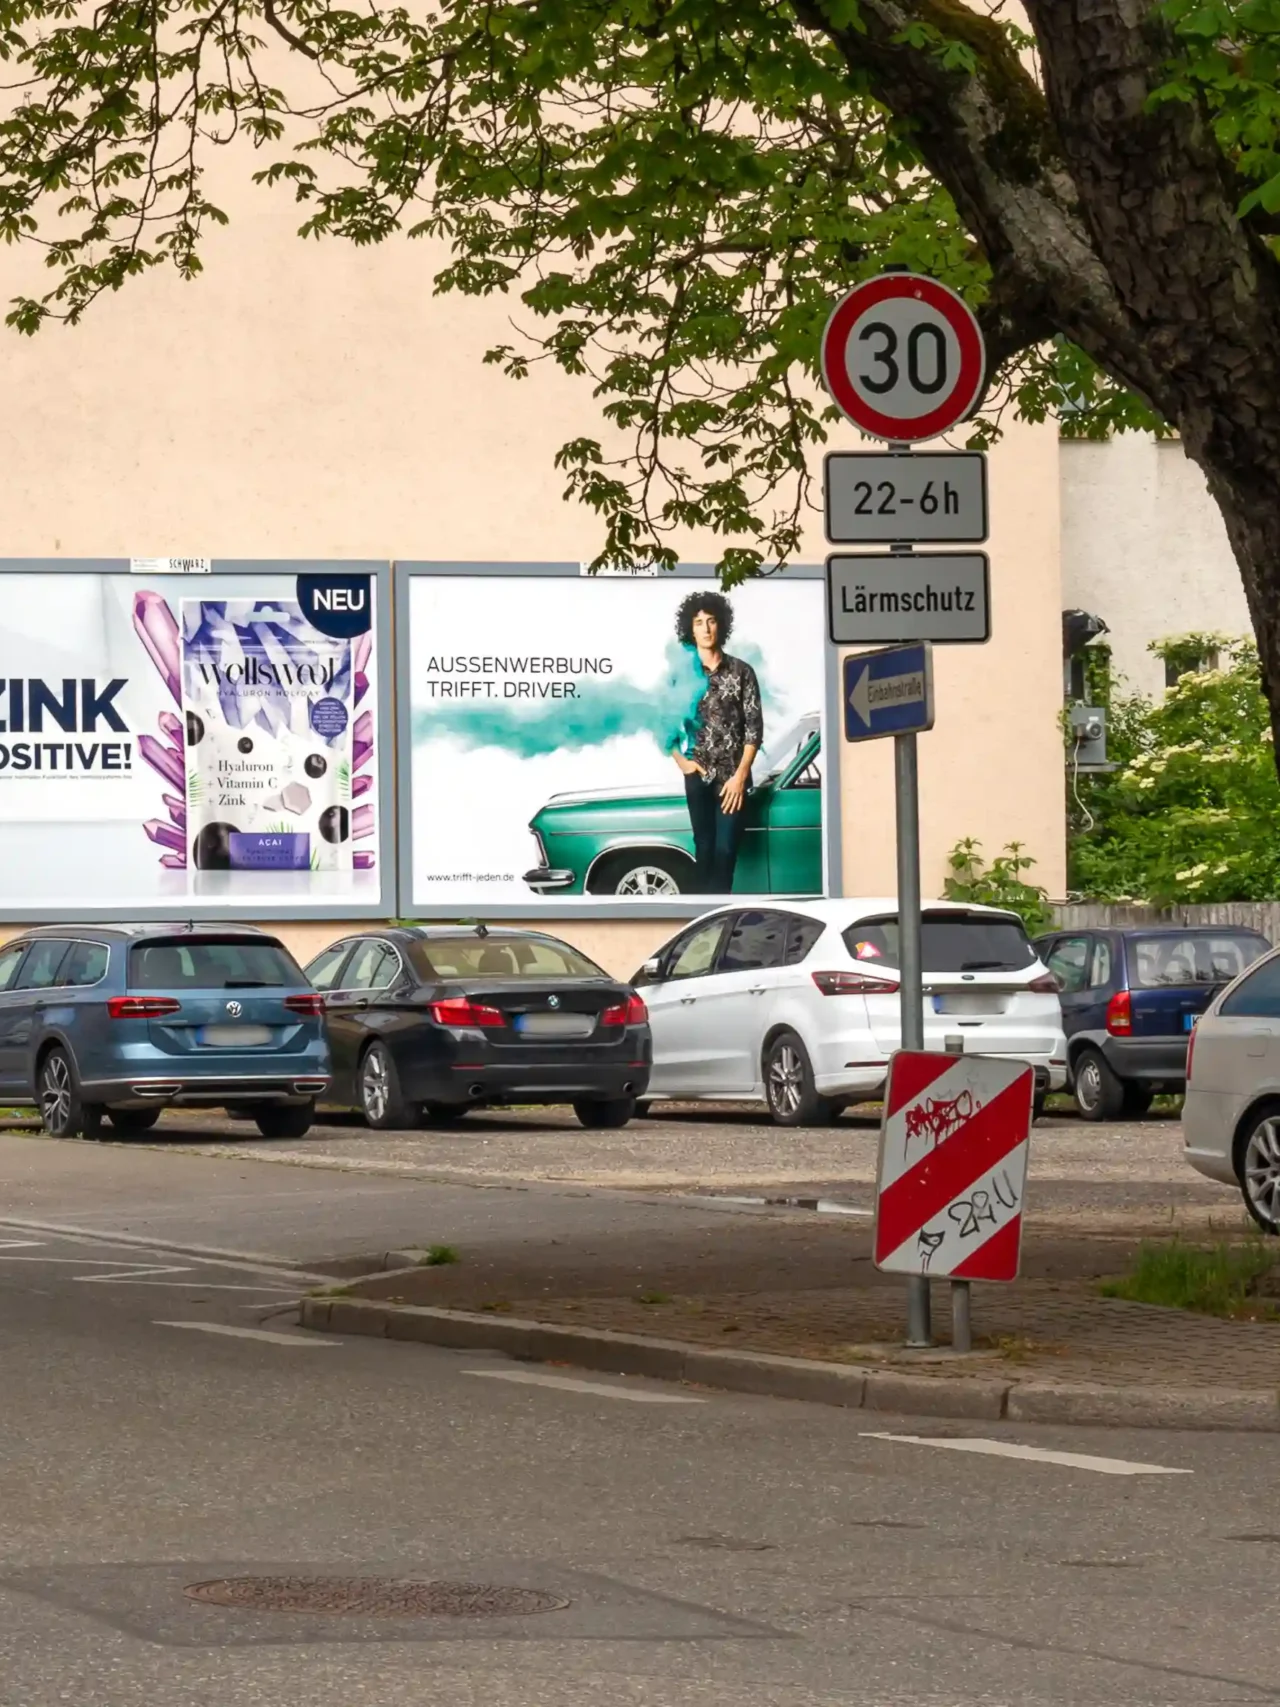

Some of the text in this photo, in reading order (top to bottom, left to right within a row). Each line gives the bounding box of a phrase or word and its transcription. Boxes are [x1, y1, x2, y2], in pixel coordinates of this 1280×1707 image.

[858, 322, 948, 395] 30
[853, 481, 960, 516] 22-6h
[313, 588, 366, 612] NEU
[841, 584, 976, 615] Lärmschutz
[426, 656, 614, 675] AUSSENWERBUNG
[426, 680, 582, 699] TRIFFT. DRIVER.
[218, 760, 274, 775] Hyaluron
[217, 777, 264, 789] Vitamin
[268, 777, 278, 789] C
[218, 794, 246, 806] Zink
[426, 872, 515, 883] www.trifft-jeden.de
